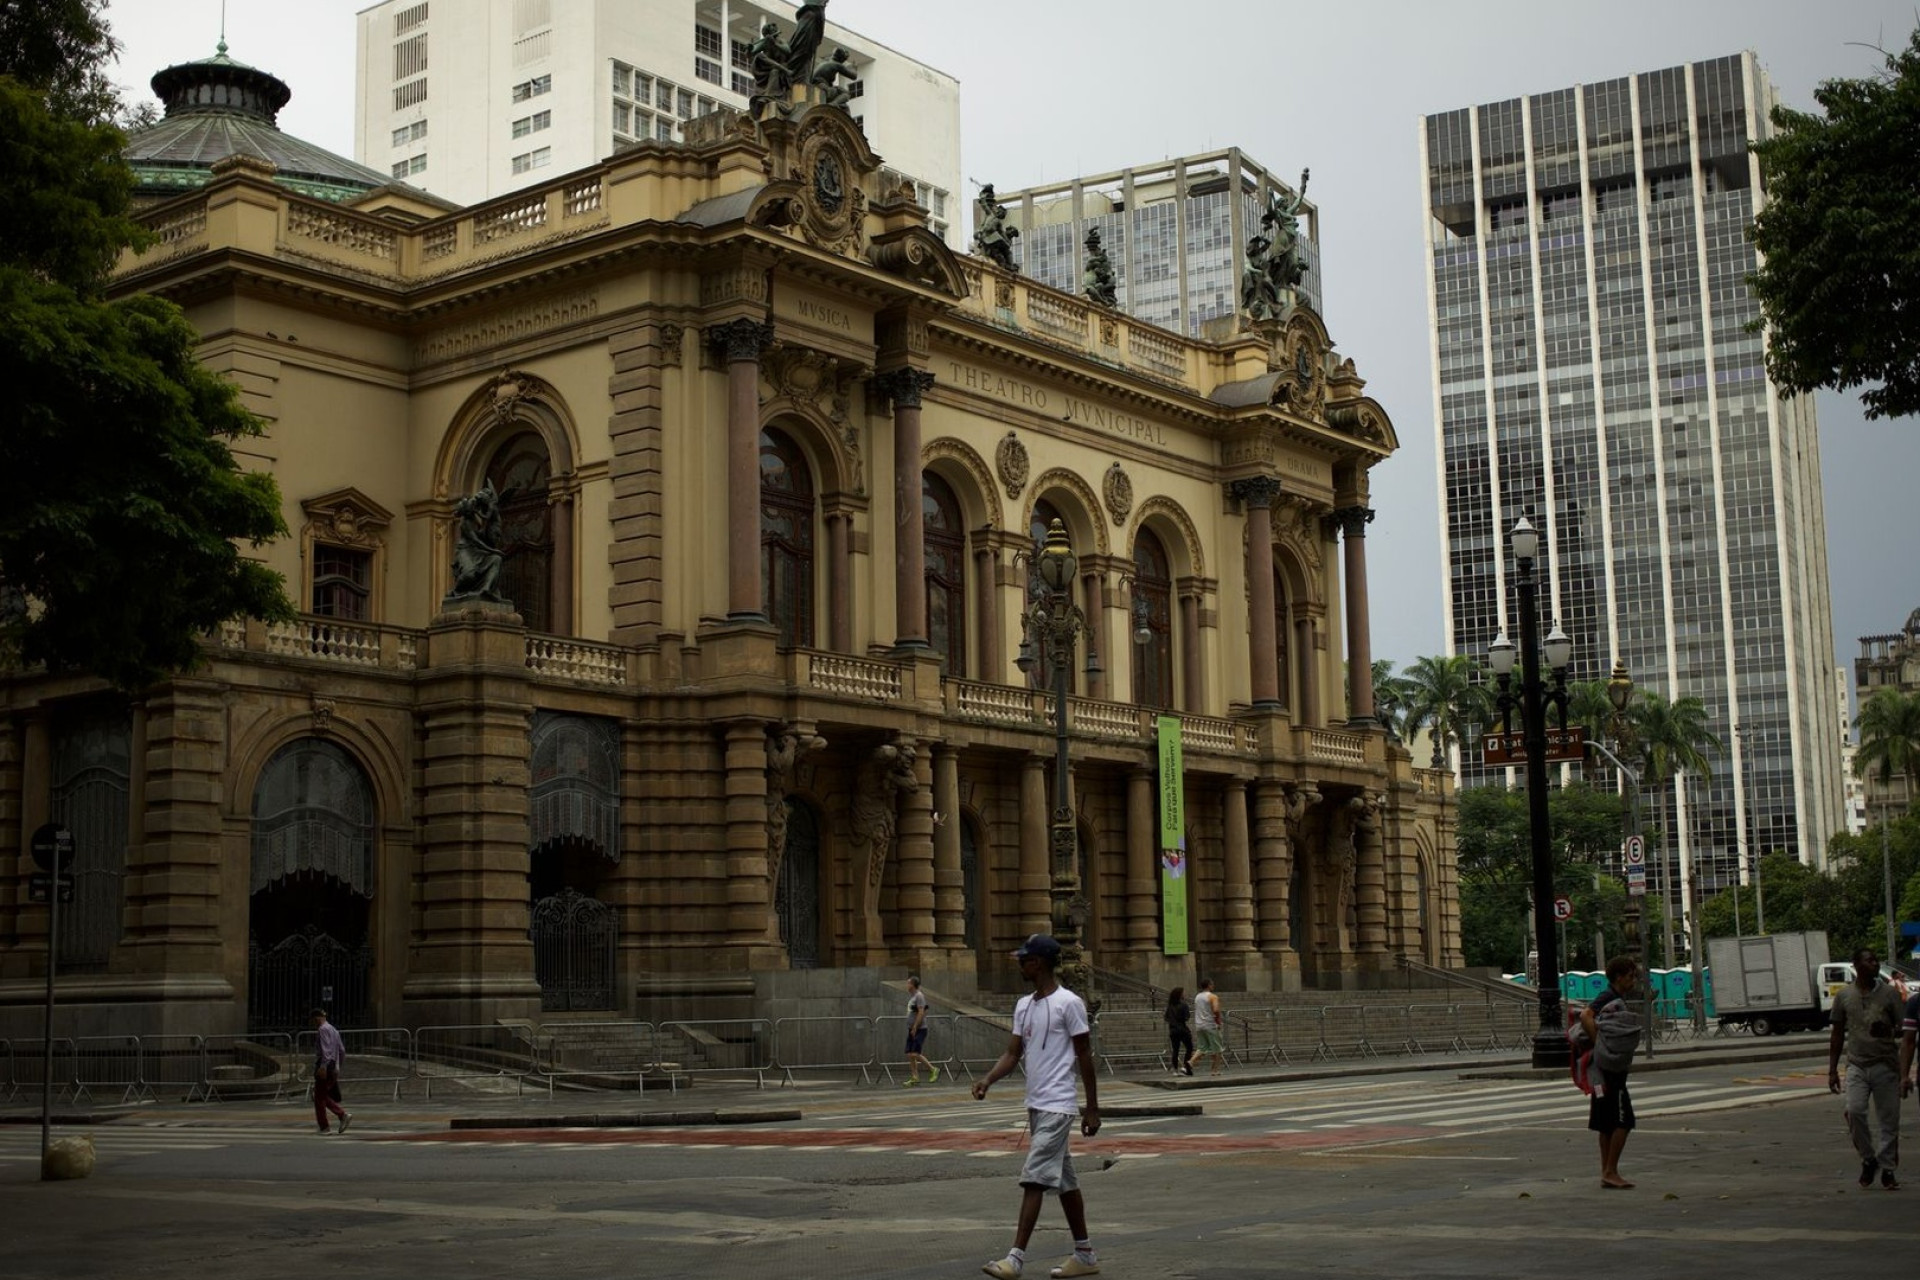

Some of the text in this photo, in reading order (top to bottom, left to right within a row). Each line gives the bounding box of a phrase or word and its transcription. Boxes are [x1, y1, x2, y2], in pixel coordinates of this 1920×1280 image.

[798, 299, 851, 330] MVSICA
[950, 362, 1166, 446] THEATRO MVNICIPAL
[1632, 843, 1639, 857] E
